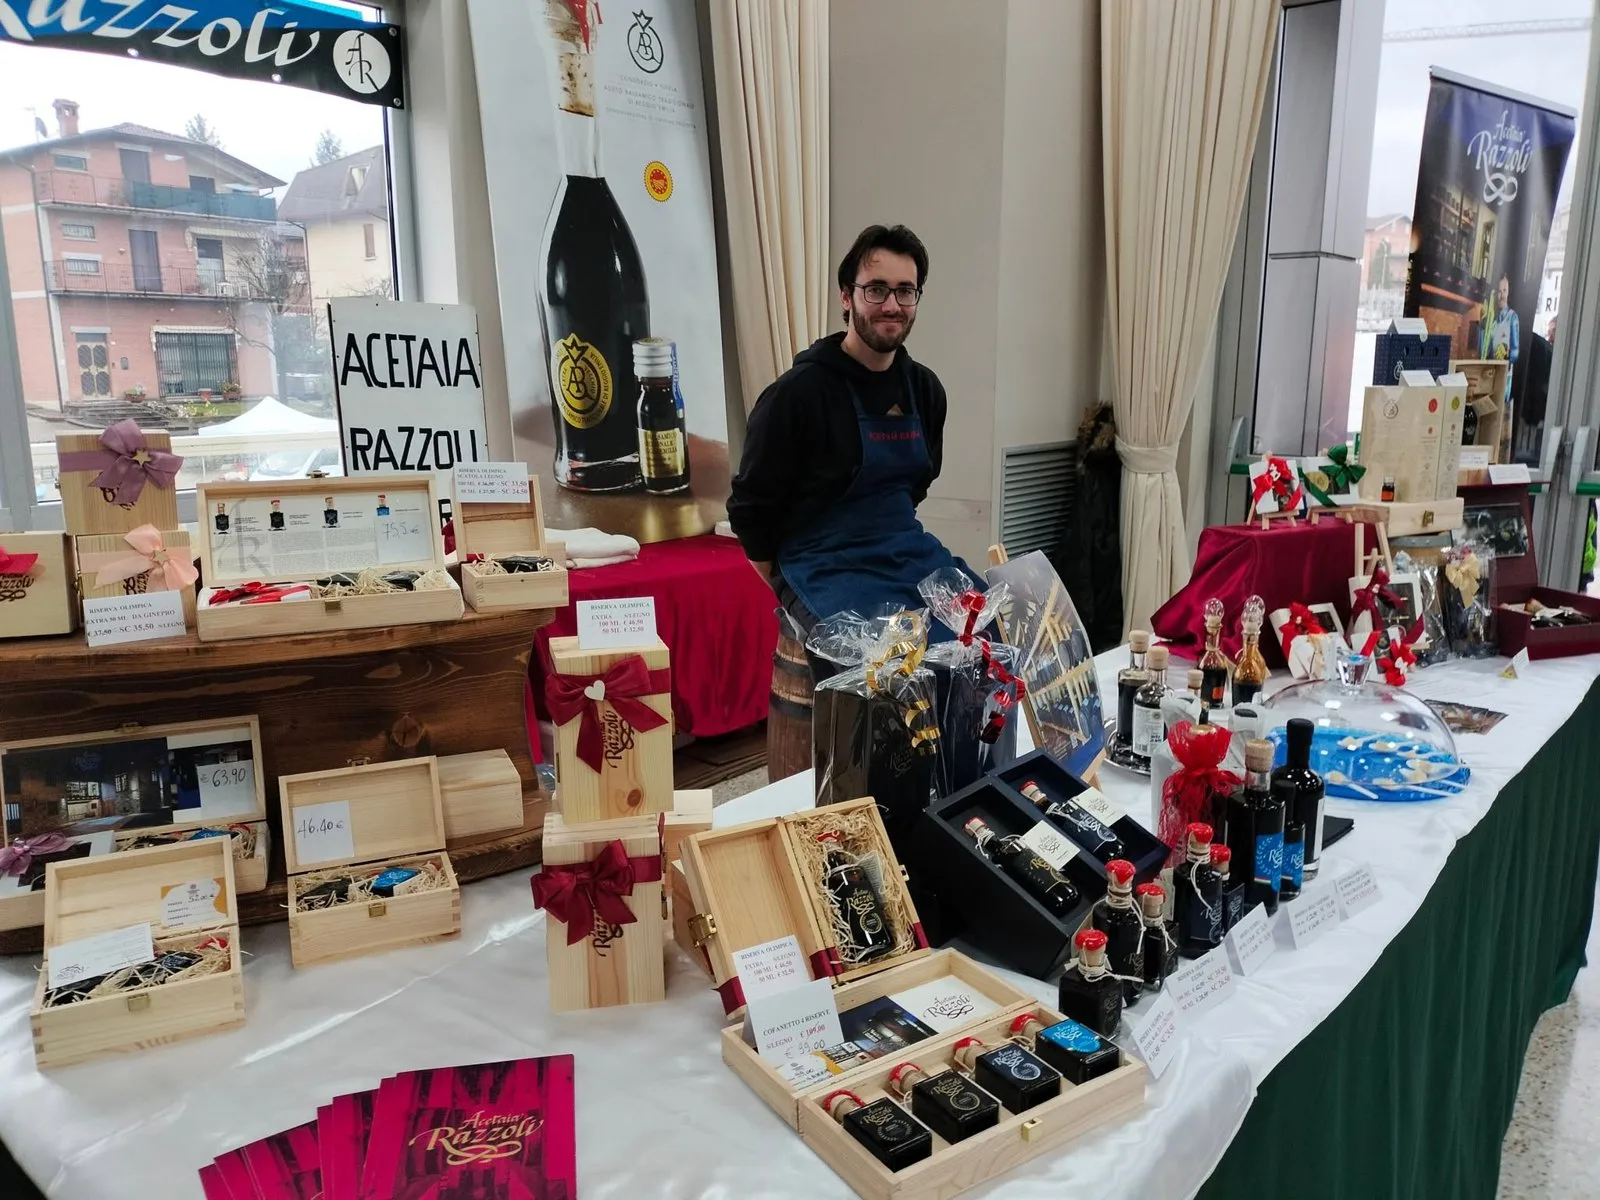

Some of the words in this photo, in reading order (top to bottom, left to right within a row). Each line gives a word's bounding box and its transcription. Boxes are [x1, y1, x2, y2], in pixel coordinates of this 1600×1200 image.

[0, 0, 320, 65] azzoli
[1467, 130, 1532, 174] Razzoli
[340, 333, 481, 388] ACETAIA
[89, 606, 118, 614] RISERVA
[119, 602, 152, 611] OLIMPICA
[143, 609, 176, 618] GINEPRO
[119, 625, 131, 633] SC
[133, 623, 154, 632] 35,50
[740, 950, 765, 960] RISERVA
[765, 942, 793, 955] OLIMPICA
[744, 961, 764, 970] EXTRA
[923, 994, 970, 1018] Razzoli
[763, 1019, 800, 1037] COFANETTO
[805, 1009, 831, 1021] RISERVE
[458, 1109, 524, 1130] Acetaia
[408, 1117, 545, 1152] Razzoli
